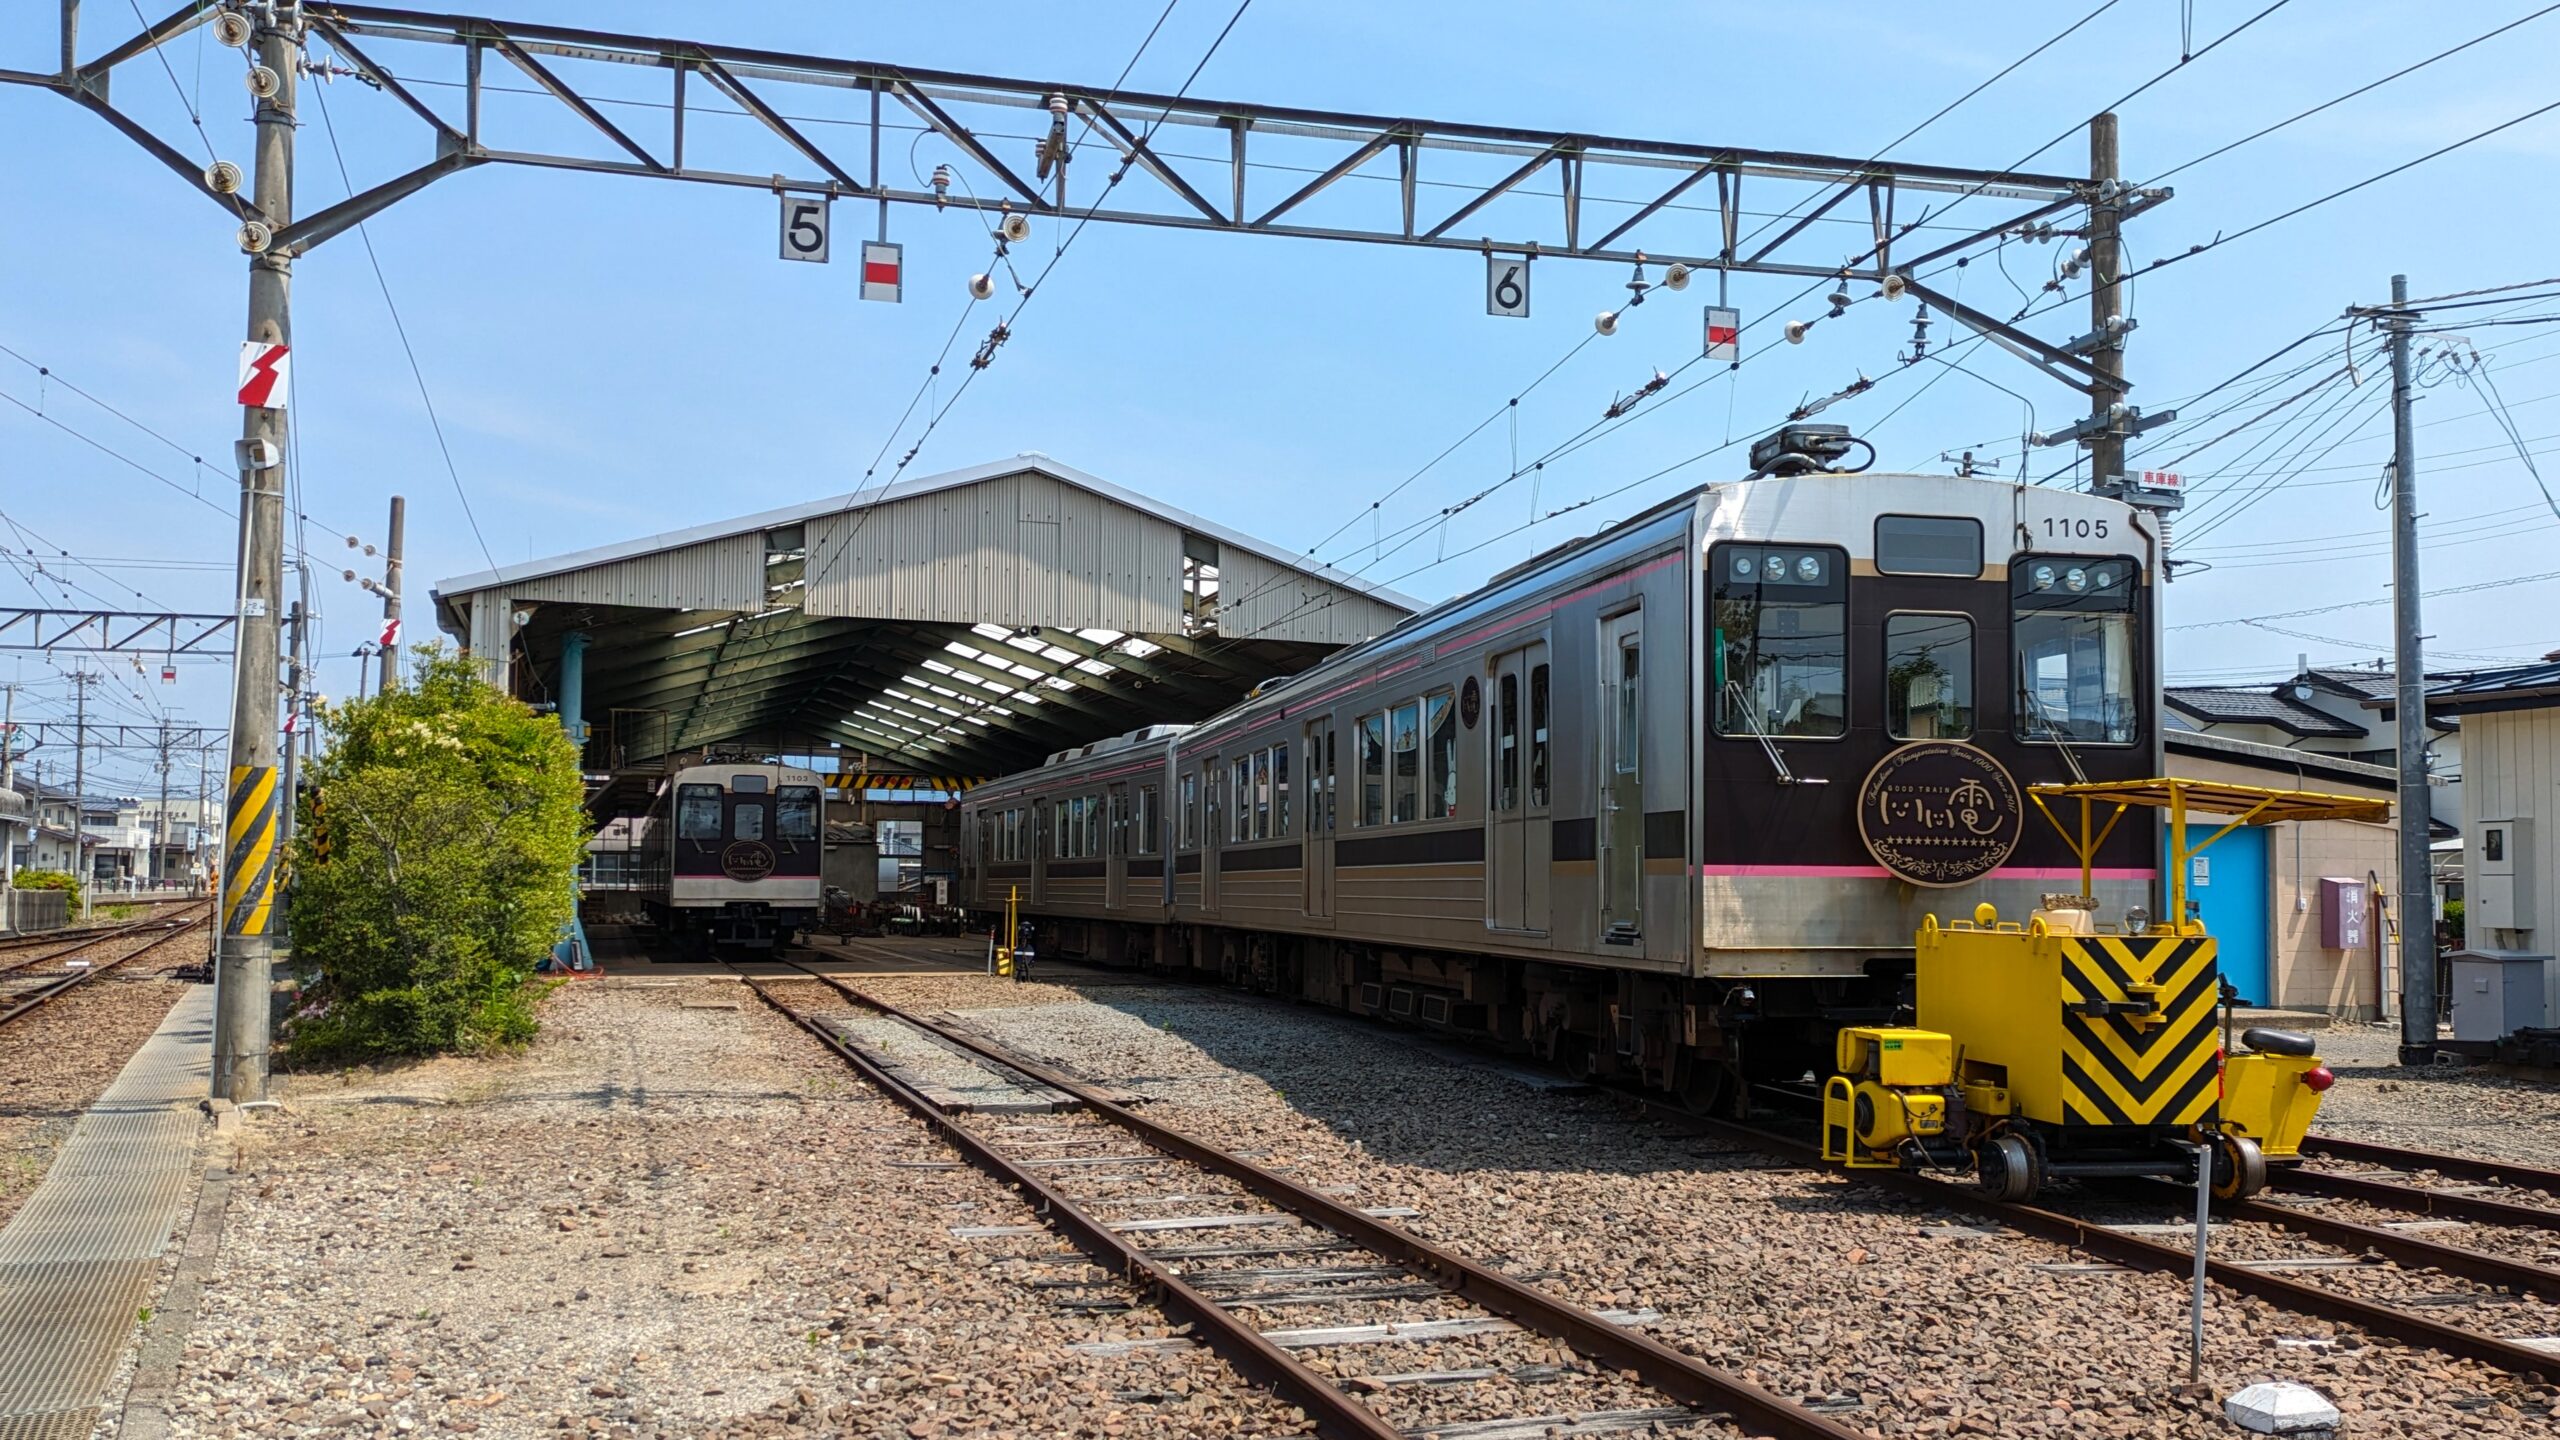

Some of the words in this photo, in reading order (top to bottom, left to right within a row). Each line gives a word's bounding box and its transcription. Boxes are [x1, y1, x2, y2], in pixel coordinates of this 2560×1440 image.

[788, 205, 823, 253] 5
[1495, 266, 1523, 309] 6
[2143, 471, 2179, 487] 車庫線
[2043, 518, 2109, 540] 1105
[1972, 757, 1995, 772] 1000
[786, 775, 809, 783] 1103
[1887, 785, 1914, 793] GOOD
[1919, 786, 1951, 794] TRAIN
[2346, 890, 2360, 944] 消火器
